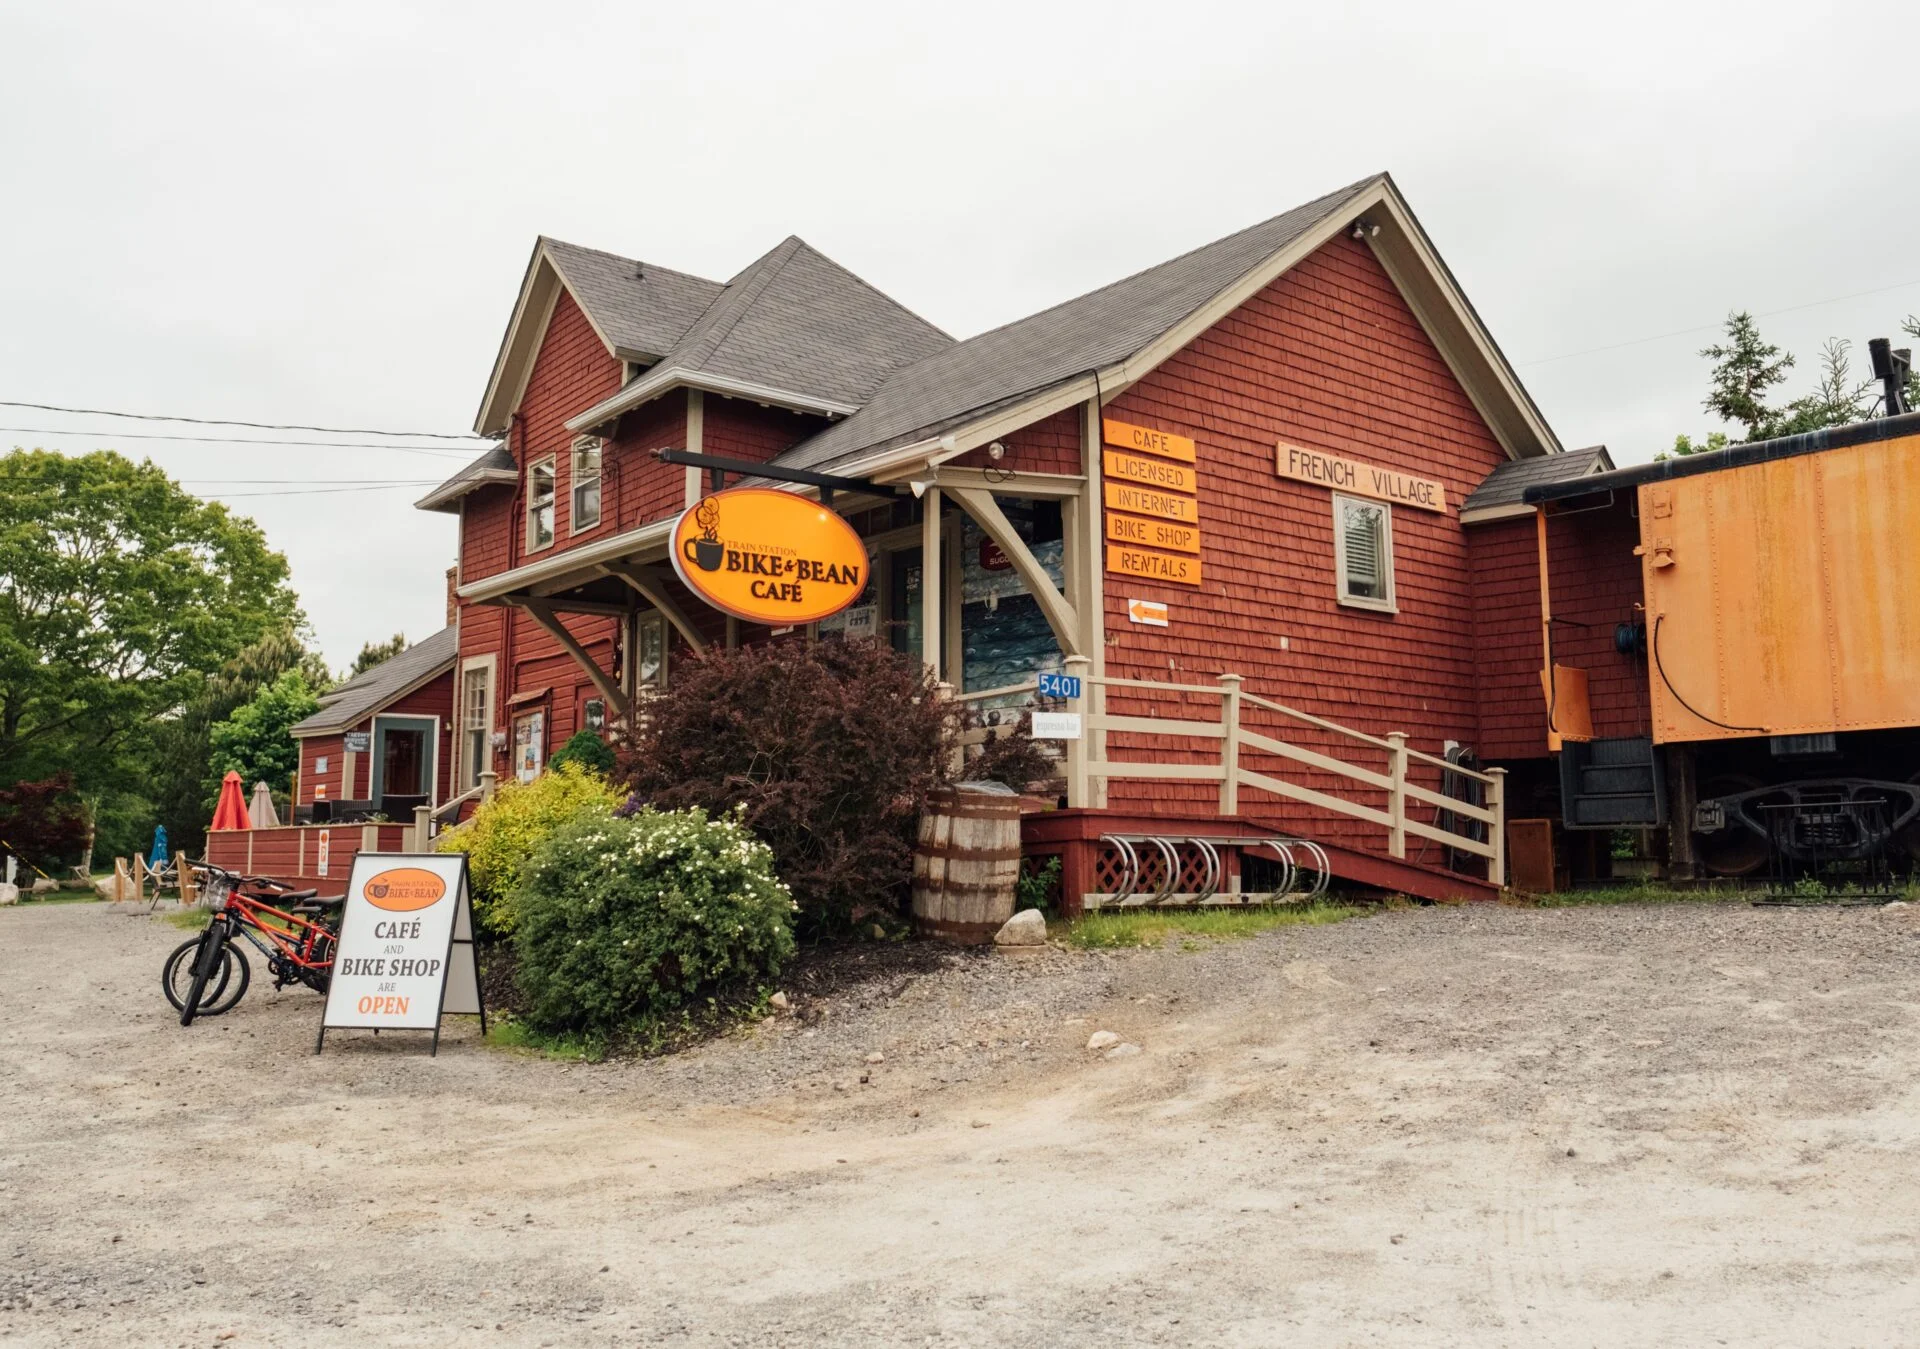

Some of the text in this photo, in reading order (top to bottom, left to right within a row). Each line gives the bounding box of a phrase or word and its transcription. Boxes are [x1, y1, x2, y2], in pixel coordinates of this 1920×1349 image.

[1134, 430, 1169, 452] CAFE
[1115, 456, 1184, 487] LICENSED
[1289, 449, 1437, 506] FRENCH VILLAGE
[1118, 488, 1186, 516] INTERNET
[1114, 519, 1192, 547] BIKE SHOP
[727, 540, 797, 556] TRAIN STATION
[1121, 551, 1187, 578] RENTALS
[751, 579, 802, 602] CAFÉ
[1040, 675, 1077, 697] 5401
[374, 917, 422, 939] CAFÉ
[384, 945, 404, 955] AND
[341, 958, 441, 977] BIKE SHOP
[377, 982, 397, 992] ARE
[358, 996, 410, 1015] OPEN
